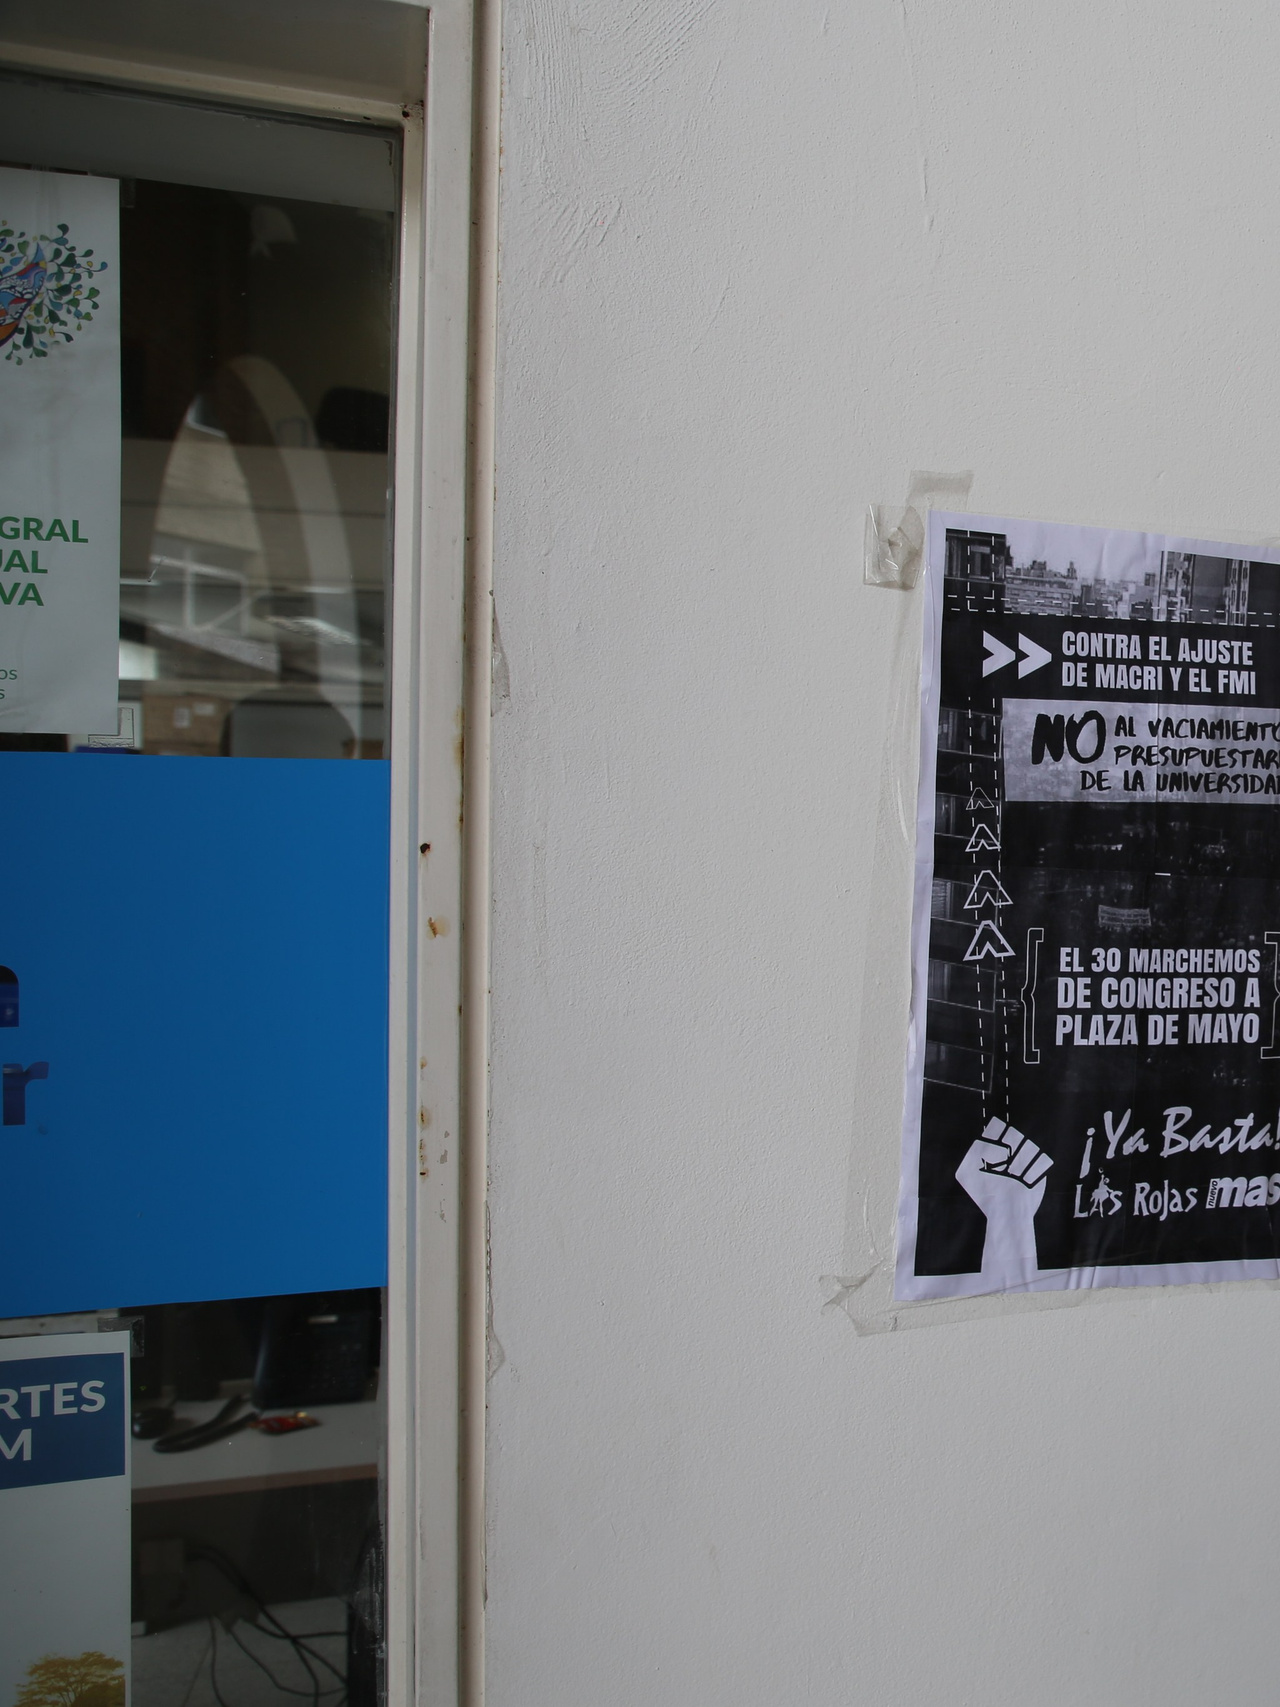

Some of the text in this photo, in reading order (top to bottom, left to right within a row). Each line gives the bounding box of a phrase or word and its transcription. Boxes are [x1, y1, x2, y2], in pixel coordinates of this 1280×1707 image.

[1061, 631, 1254, 667] CONTRA EL AJUSTE
[1061, 661, 1257, 696] DE MACRI Y EL FMI
[1031, 709, 1107, 766] NO
[1115, 715, 1137, 738] AL
[1080, 770, 1112, 792] DE
[1123, 770, 1145, 793] LA
[1060, 946, 1261, 974] EL 30 MARCHEMOS
[1056, 977, 1261, 1009] DE CONGRESO A
[1055, 1012, 1260, 1046] PLAZA DE MAYO
[1080, 1109, 1150, 1180] ¡Ya
[1206, 1178, 1220, 1209] nuevo
